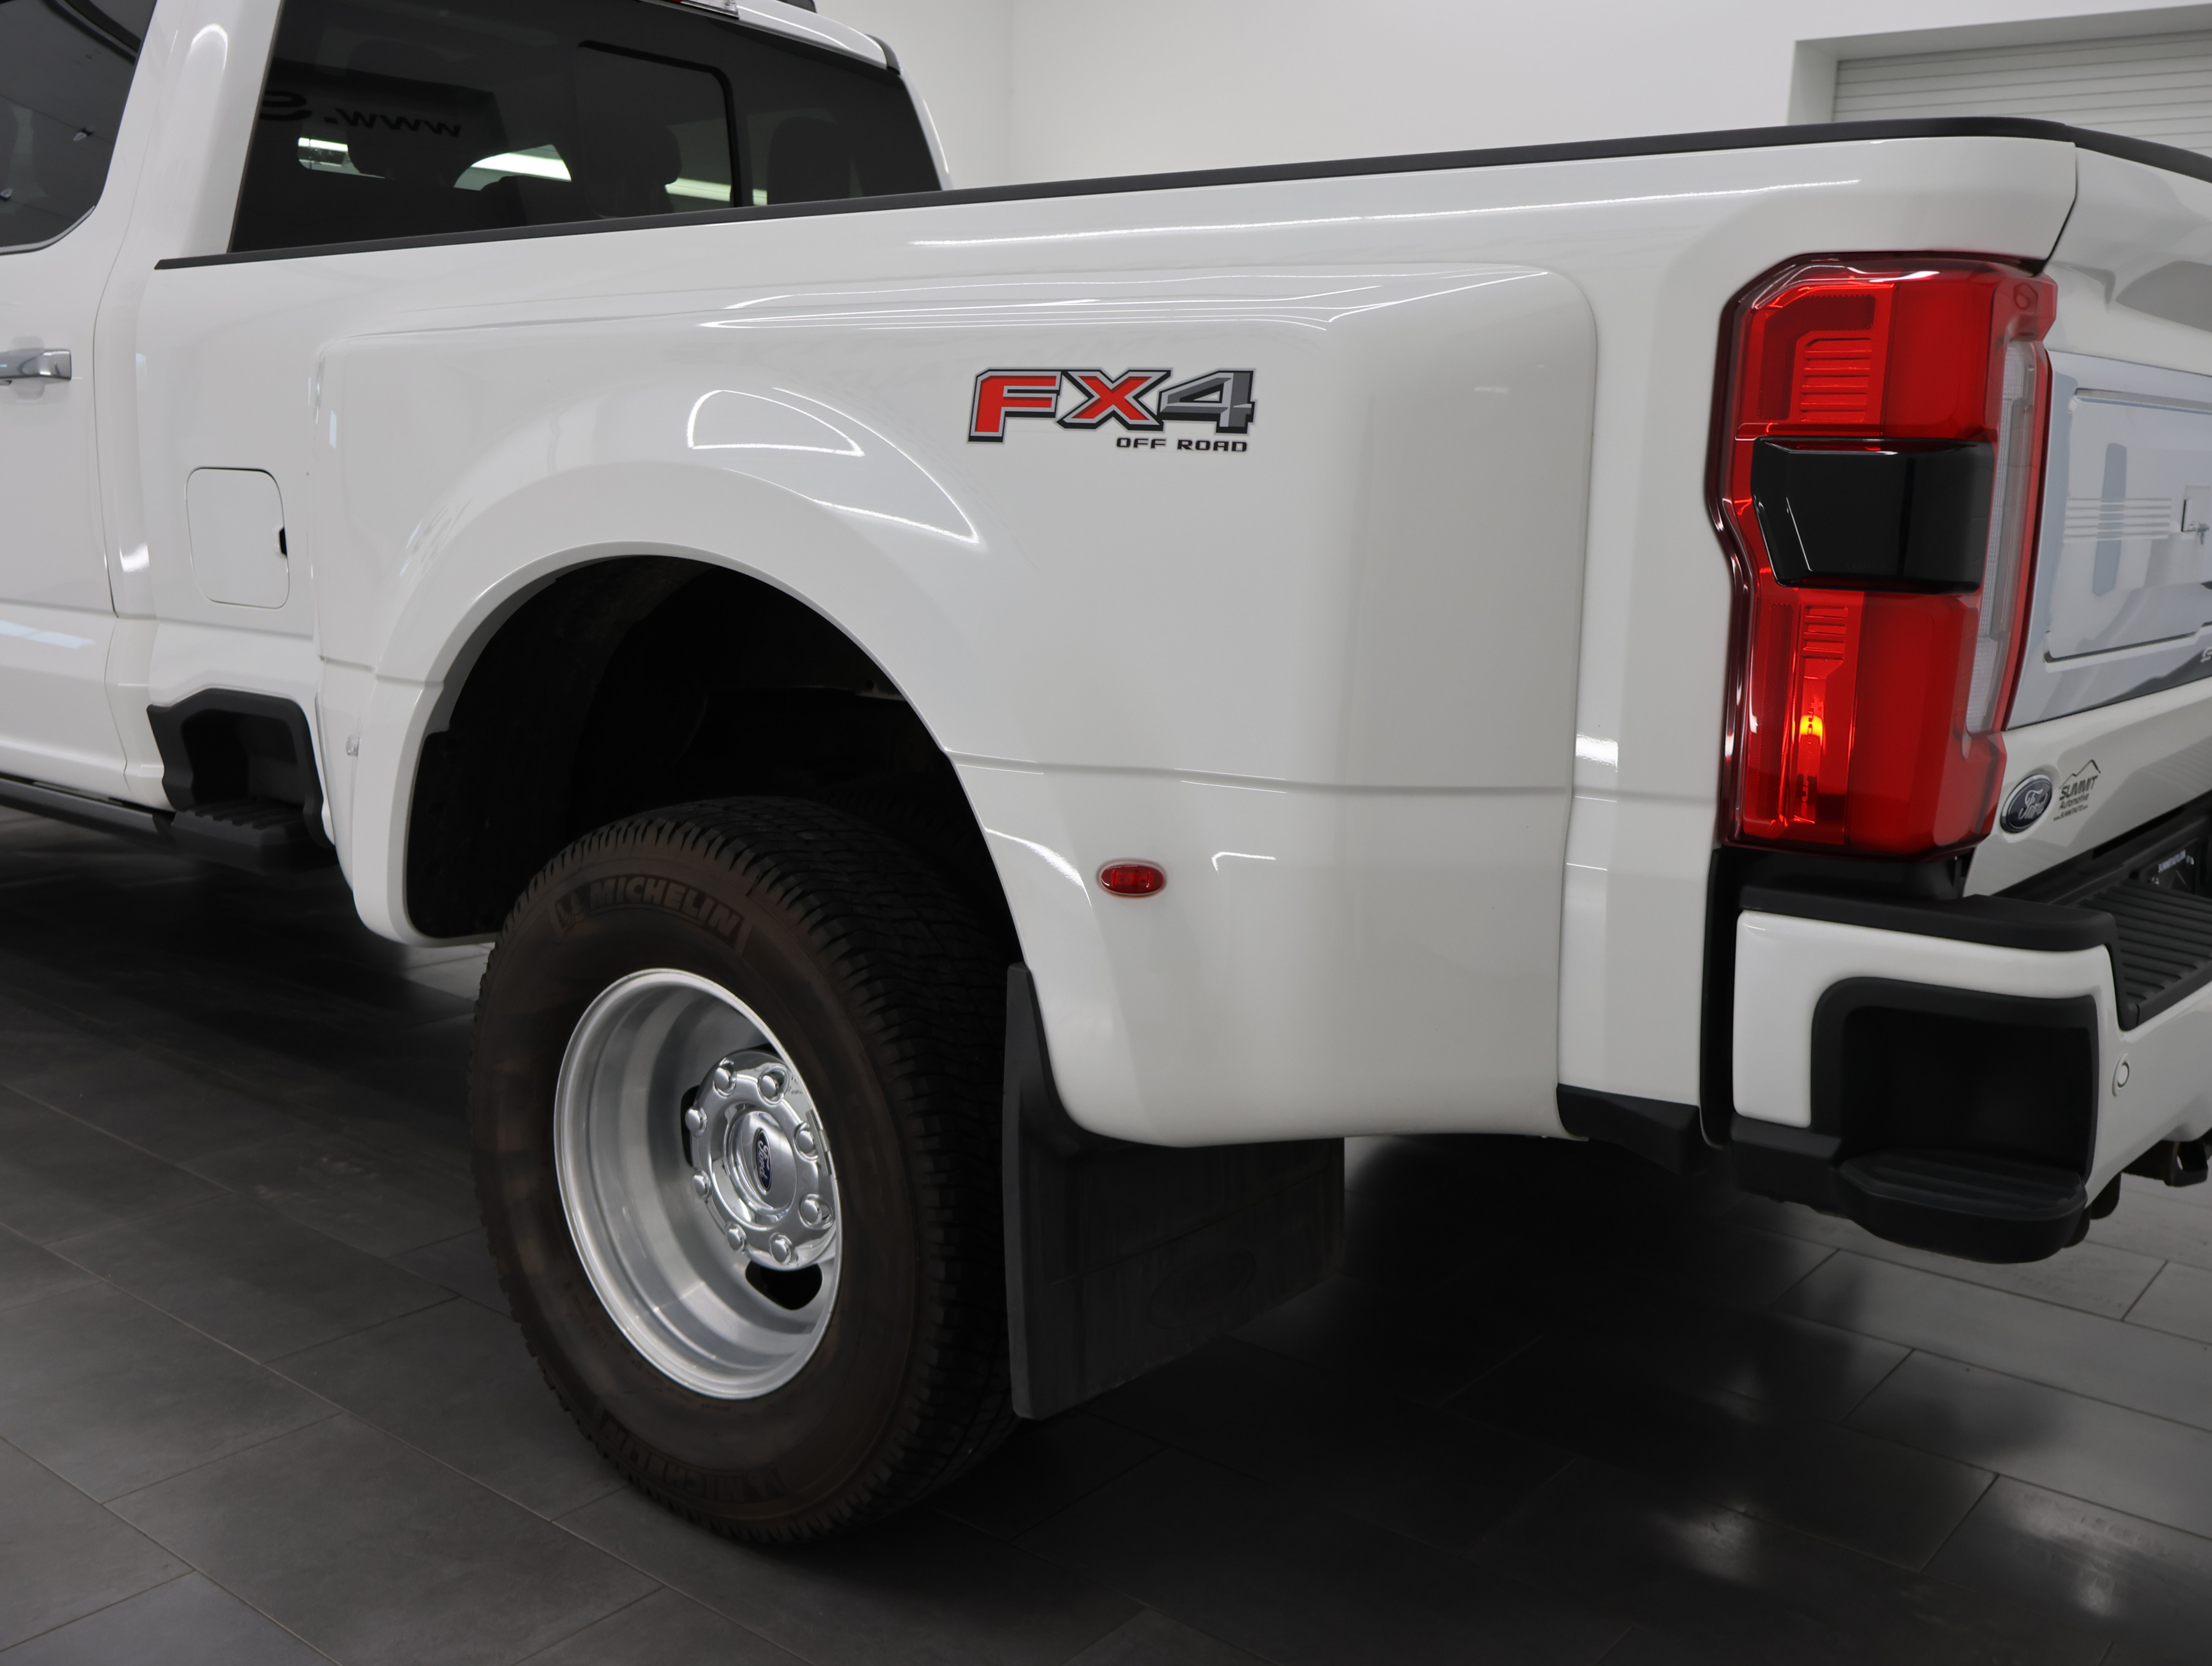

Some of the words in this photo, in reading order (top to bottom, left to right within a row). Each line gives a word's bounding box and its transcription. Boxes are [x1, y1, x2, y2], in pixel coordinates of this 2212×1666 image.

[967, 368, 1256, 444] FX4
[1116, 437, 1166, 449] OFF
[1177, 439, 1248, 452] ROAD
[2059, 775, 2099, 801] SUMMIT
[589, 876, 741, 938] MICHELIN
[758, 1140, 770, 1180] Ford
[599, 1419, 745, 1502] MICHELIN
